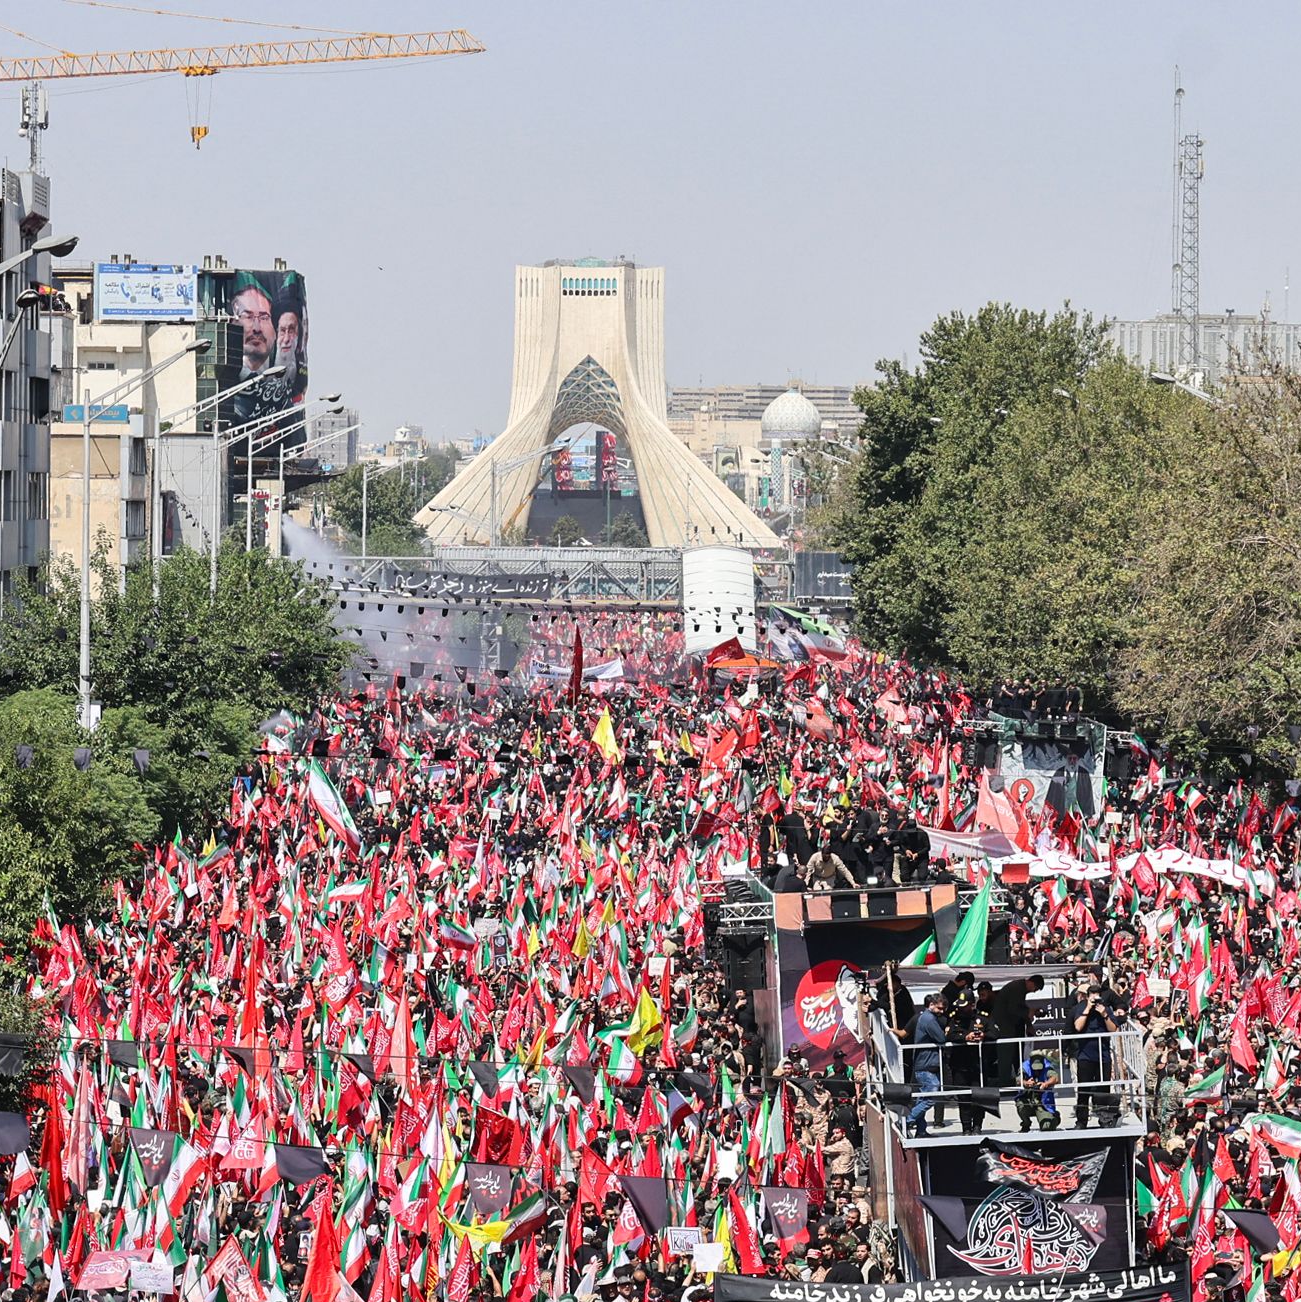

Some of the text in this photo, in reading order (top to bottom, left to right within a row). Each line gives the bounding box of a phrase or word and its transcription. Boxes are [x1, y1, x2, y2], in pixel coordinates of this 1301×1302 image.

[520, 580, 539, 594] زنده
[541, 578, 548, 593] تو
[1106, 1266, 1156, 1299] اهالی
[1158, 1265, 1177, 1285] ما
[769, 1282, 827, 1302] خامنه
[1004, 1276, 1062, 1301] خامنه
